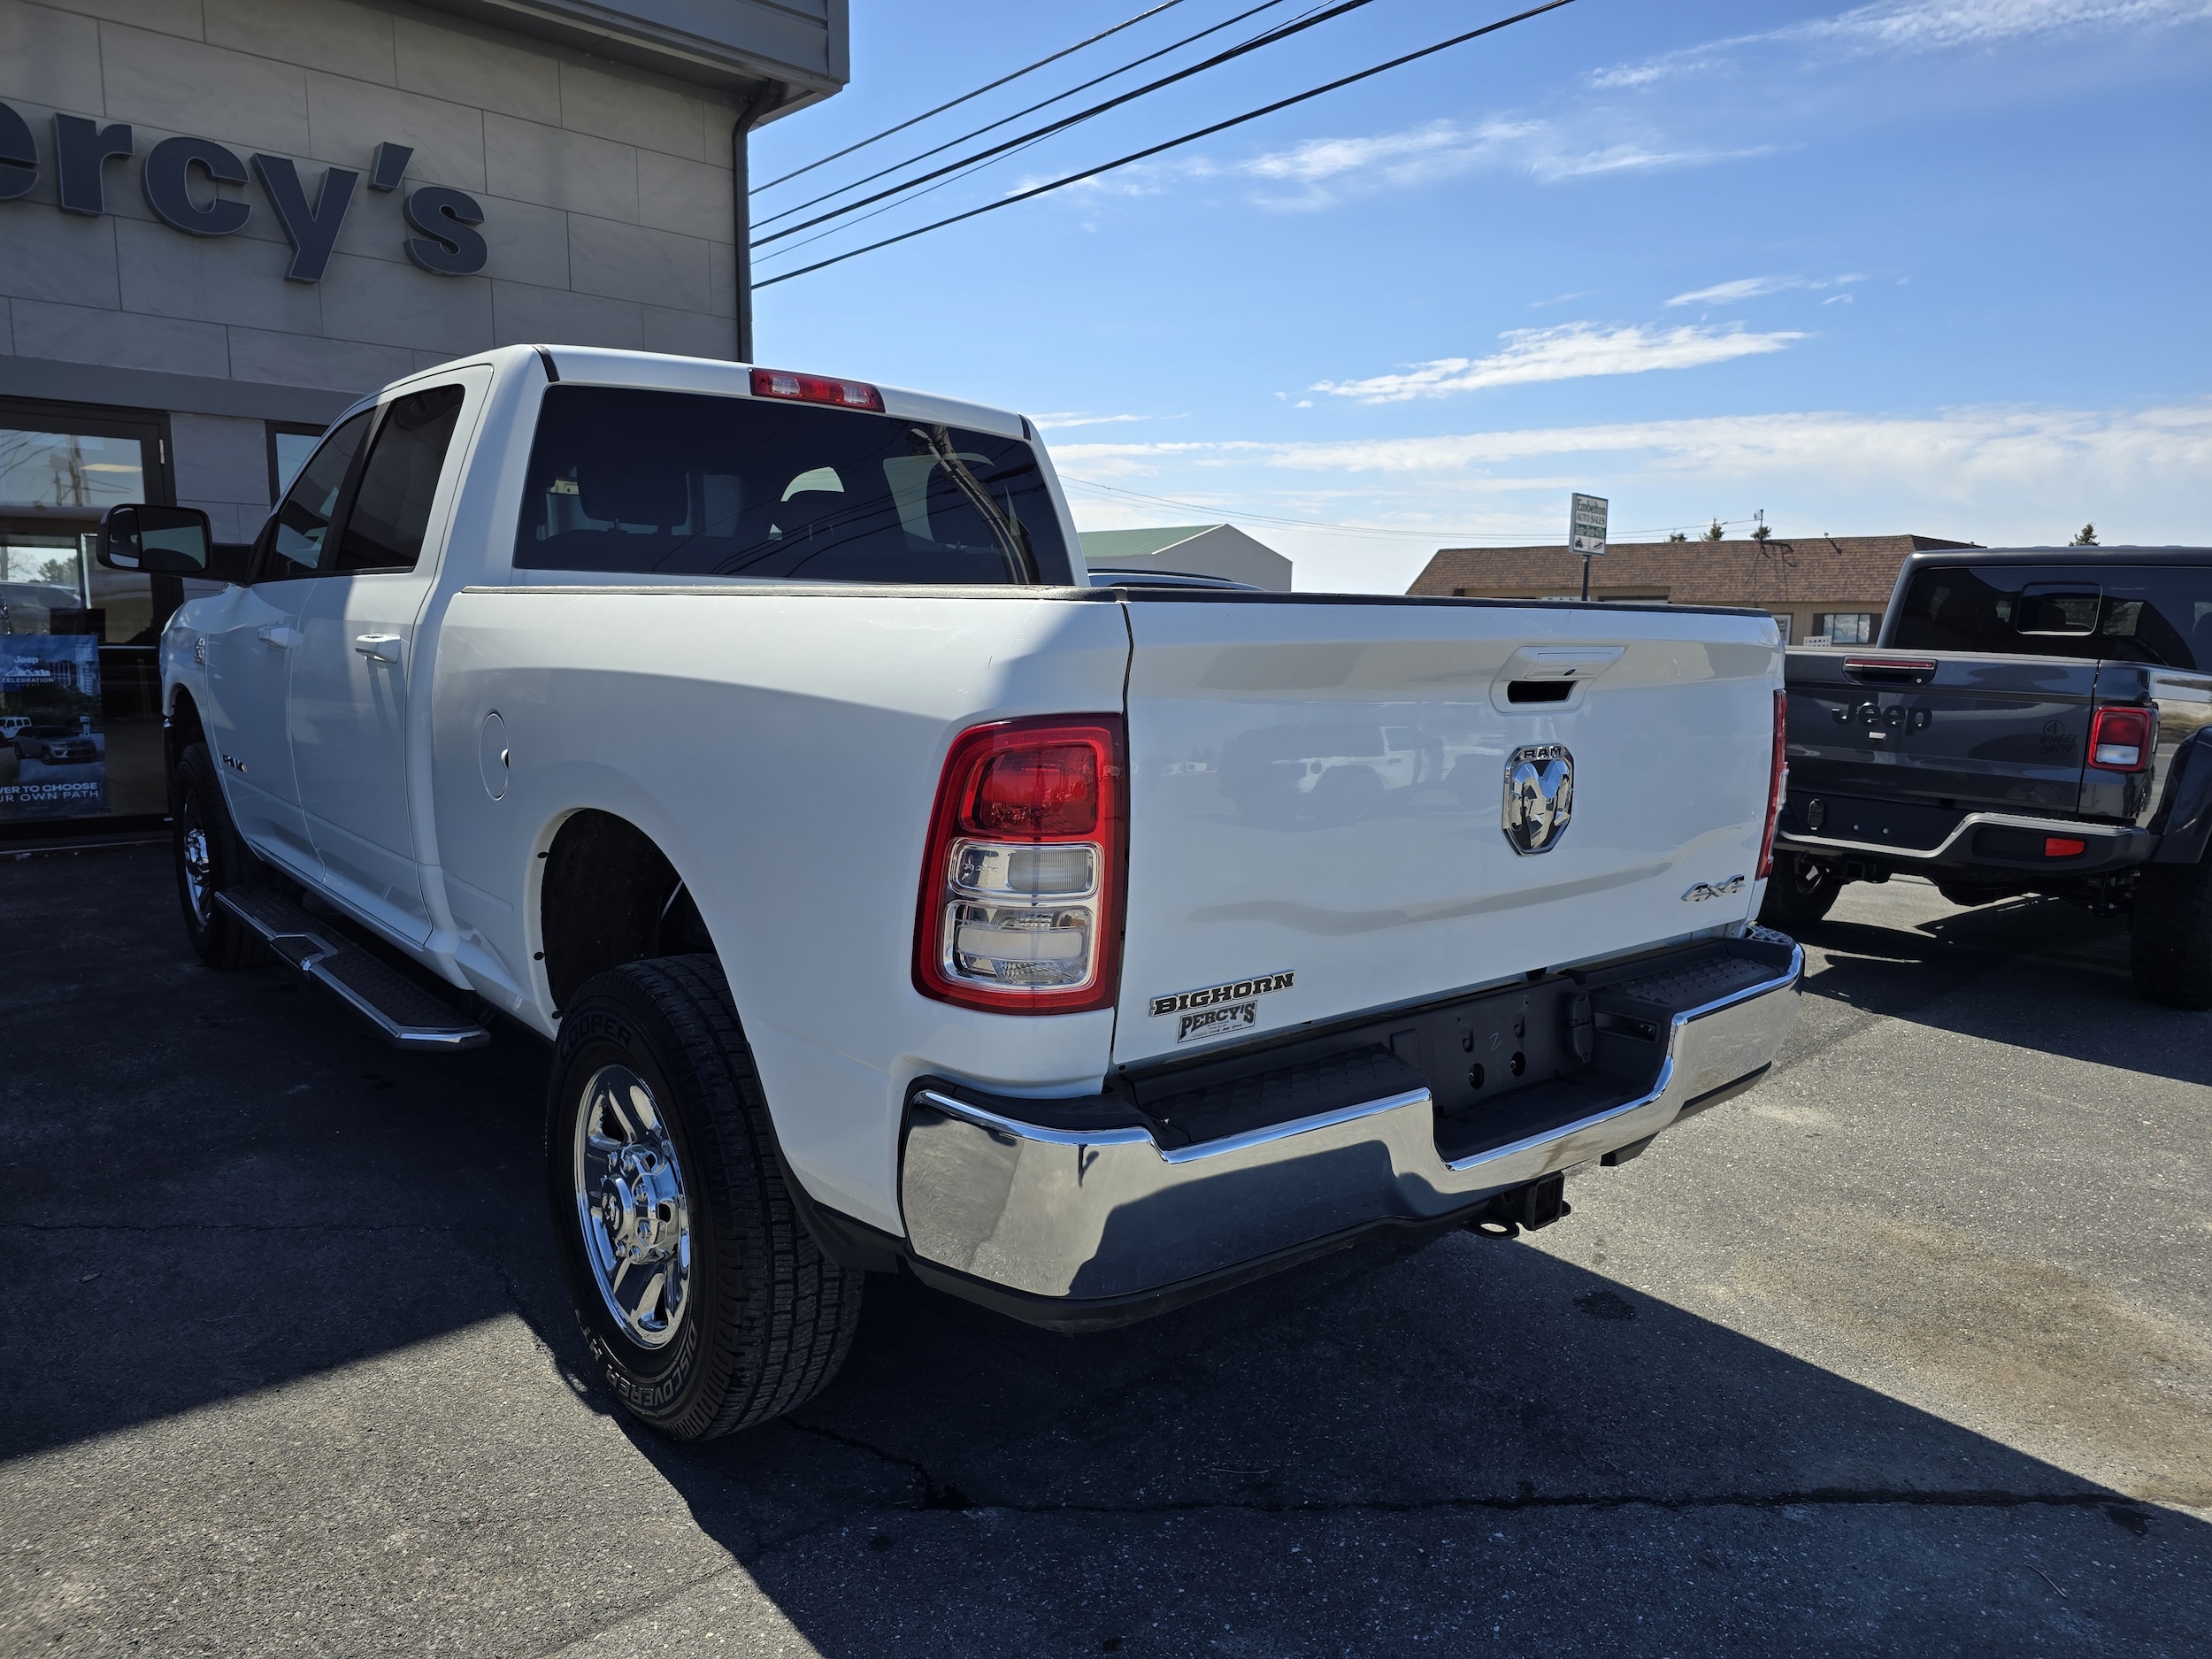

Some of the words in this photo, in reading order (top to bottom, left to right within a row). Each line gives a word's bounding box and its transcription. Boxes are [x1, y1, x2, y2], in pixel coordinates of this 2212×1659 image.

[1590, 515, 1605, 525] SALES
[13, 655, 39, 664] Jeep
[1831, 695, 1933, 736] Jeep
[2039, 734, 2078, 745] WHEEL
[1524, 748, 1562, 758] RAM
[2039, 744, 2077, 755] DRIVE
[22, 784, 40, 793] TO
[42, 782, 98, 793] CHOOSE
[19, 791, 58, 802] OWN
[63, 790, 99, 799] PATH
[1151, 972, 1295, 1017] BIGHORN
[1179, 1002, 1256, 1041] PERCY'S
[560, 1013, 633, 1064] COOPER
[605, 1318, 699, 1408] DISCOVERER
